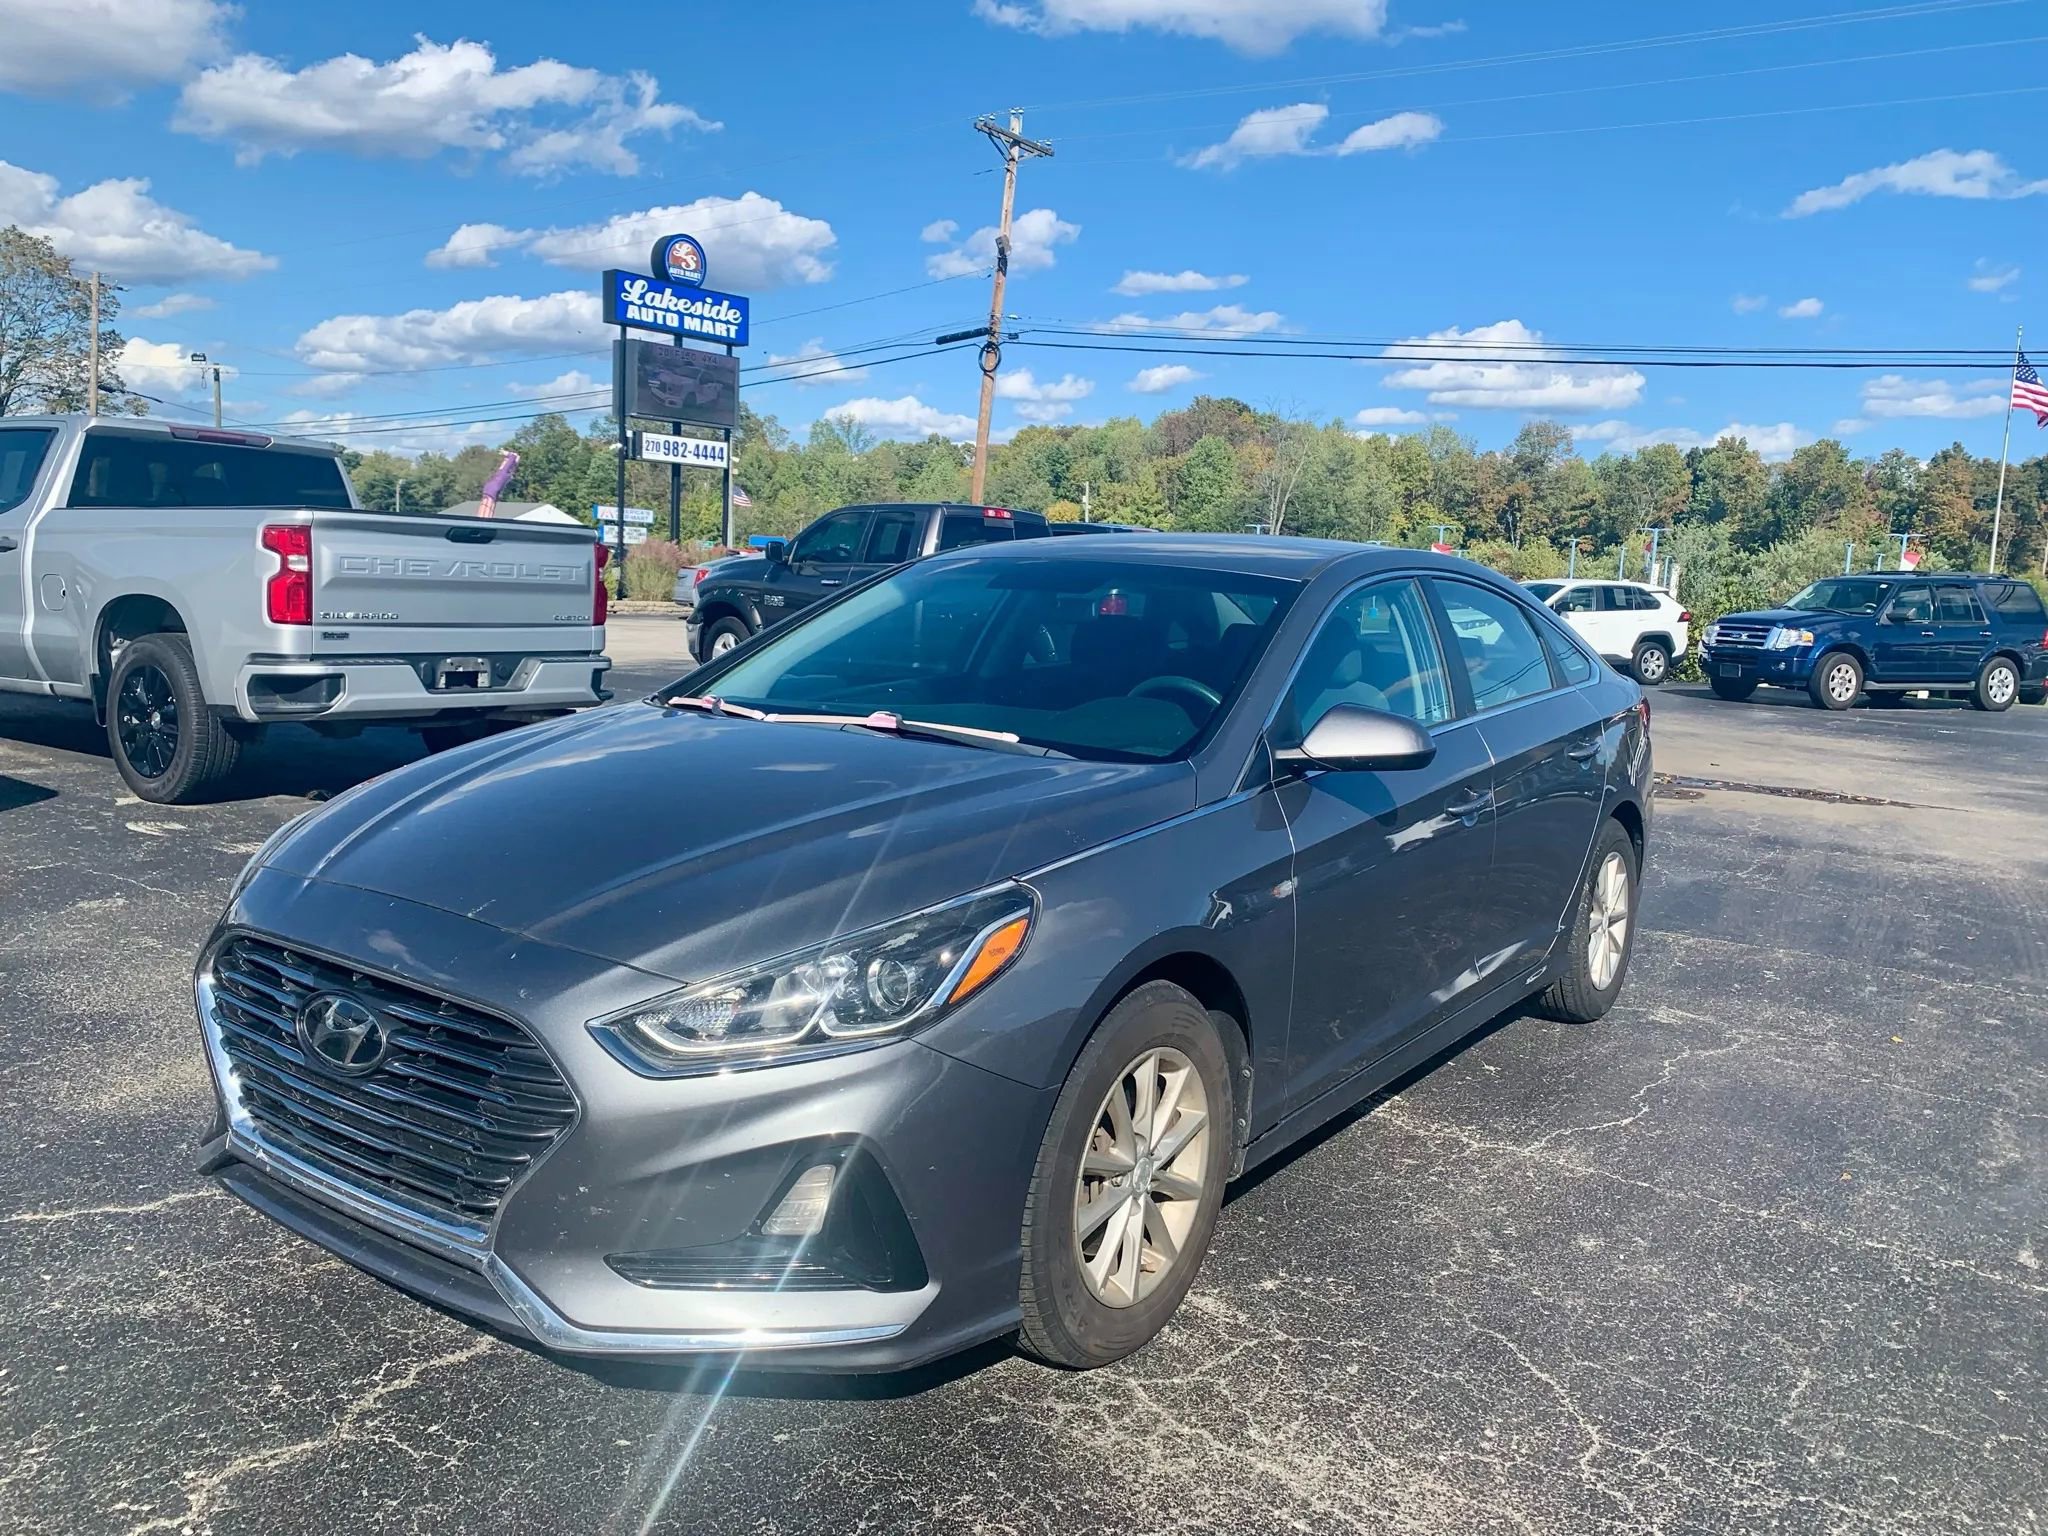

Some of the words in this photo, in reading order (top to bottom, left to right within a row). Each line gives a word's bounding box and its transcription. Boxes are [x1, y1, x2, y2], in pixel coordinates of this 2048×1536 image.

[620, 279, 743, 324] Lakeside
[626, 305, 679, 328] AUTO
[683, 315, 739, 339] MART
[645, 439, 661, 453] 270
[663, 439, 725, 463] 982-4444
[339, 555, 584, 582] CHEVROLET
[319, 611, 399, 620] SILVERADO
